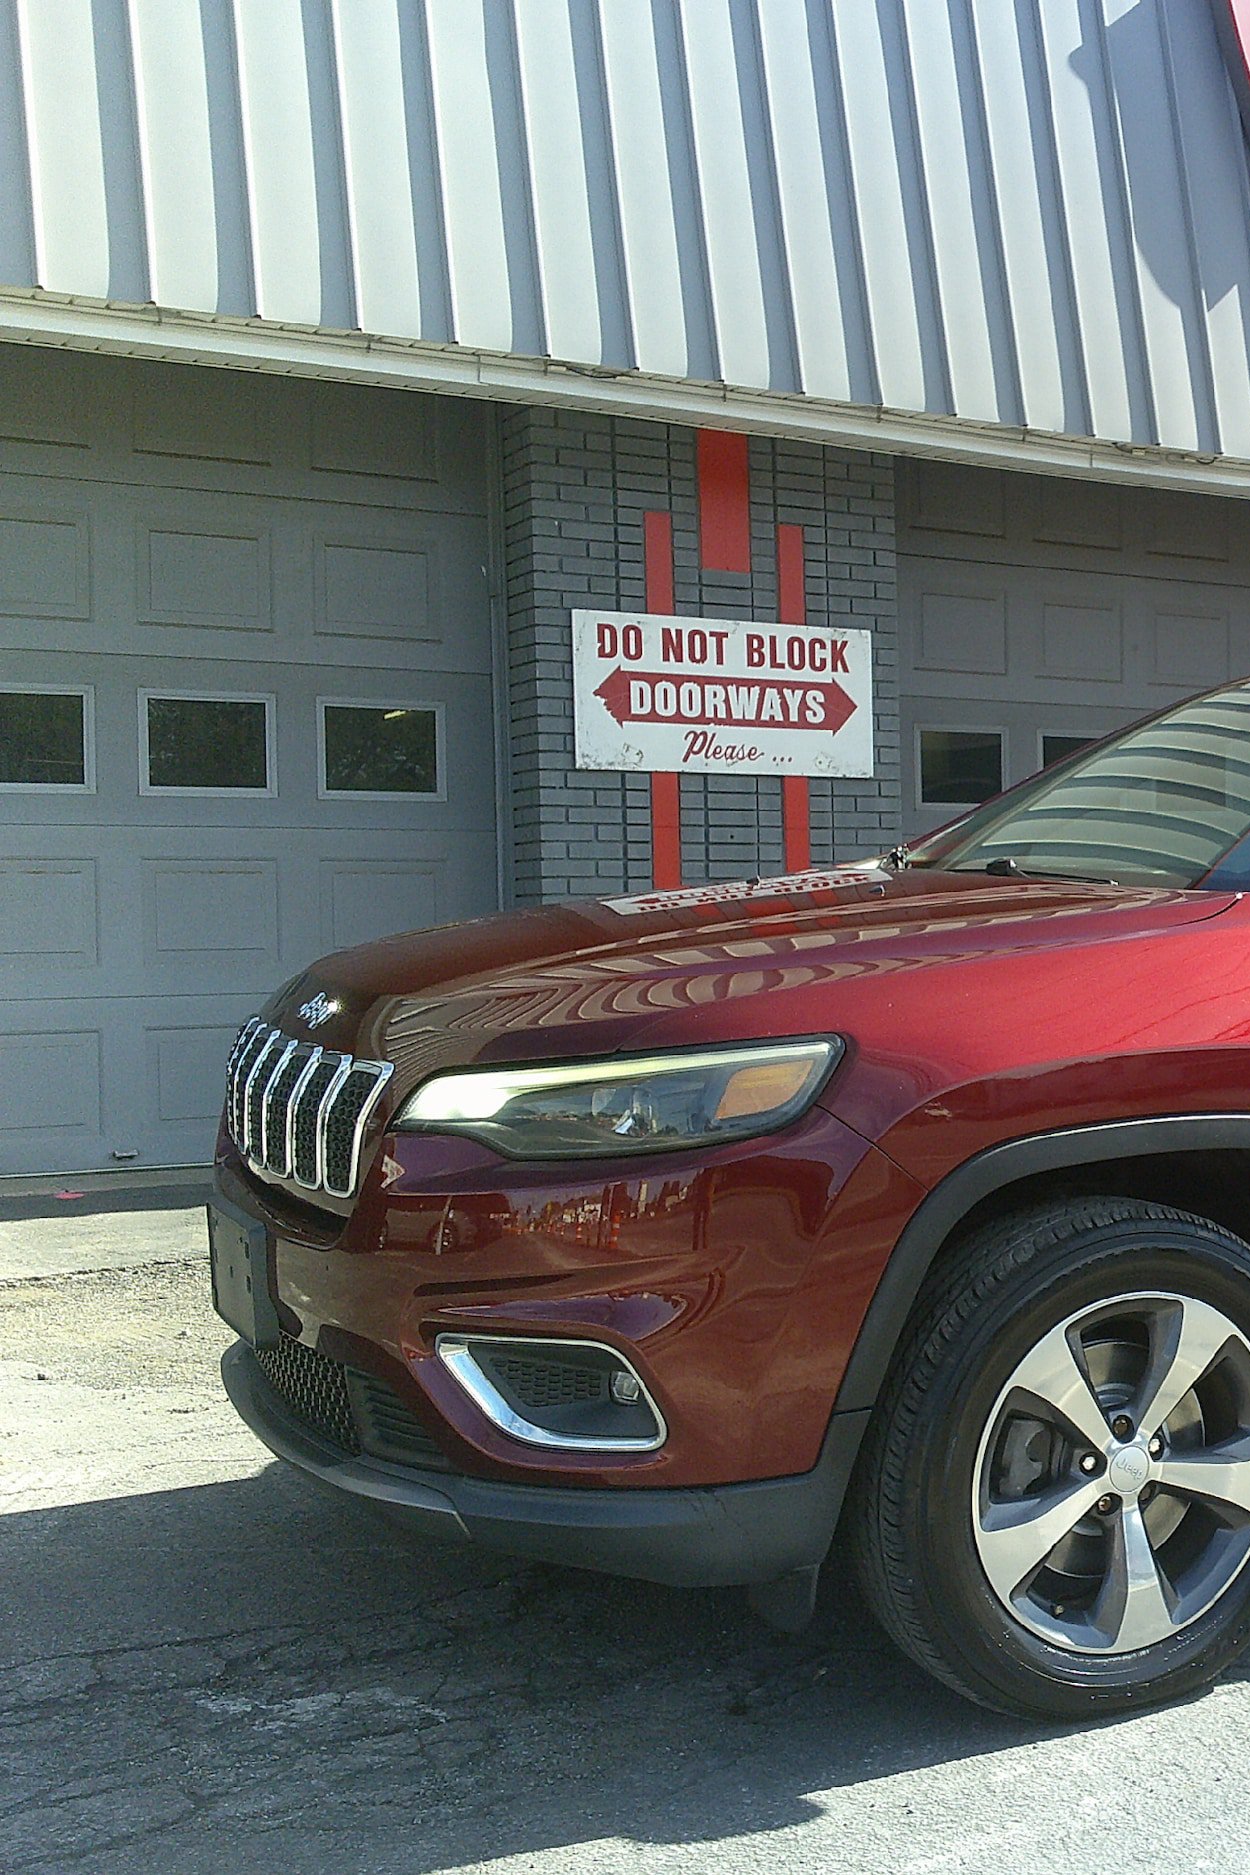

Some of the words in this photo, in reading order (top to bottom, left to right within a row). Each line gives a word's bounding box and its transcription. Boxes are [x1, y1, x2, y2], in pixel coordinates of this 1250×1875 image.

[596, 623, 644, 661] DO
[661, 628, 729, 666] NOT
[746, 633, 850, 673] BLOCK
[630, 680, 826, 725] DOORWAYS
[682, 730, 764, 763] Please
